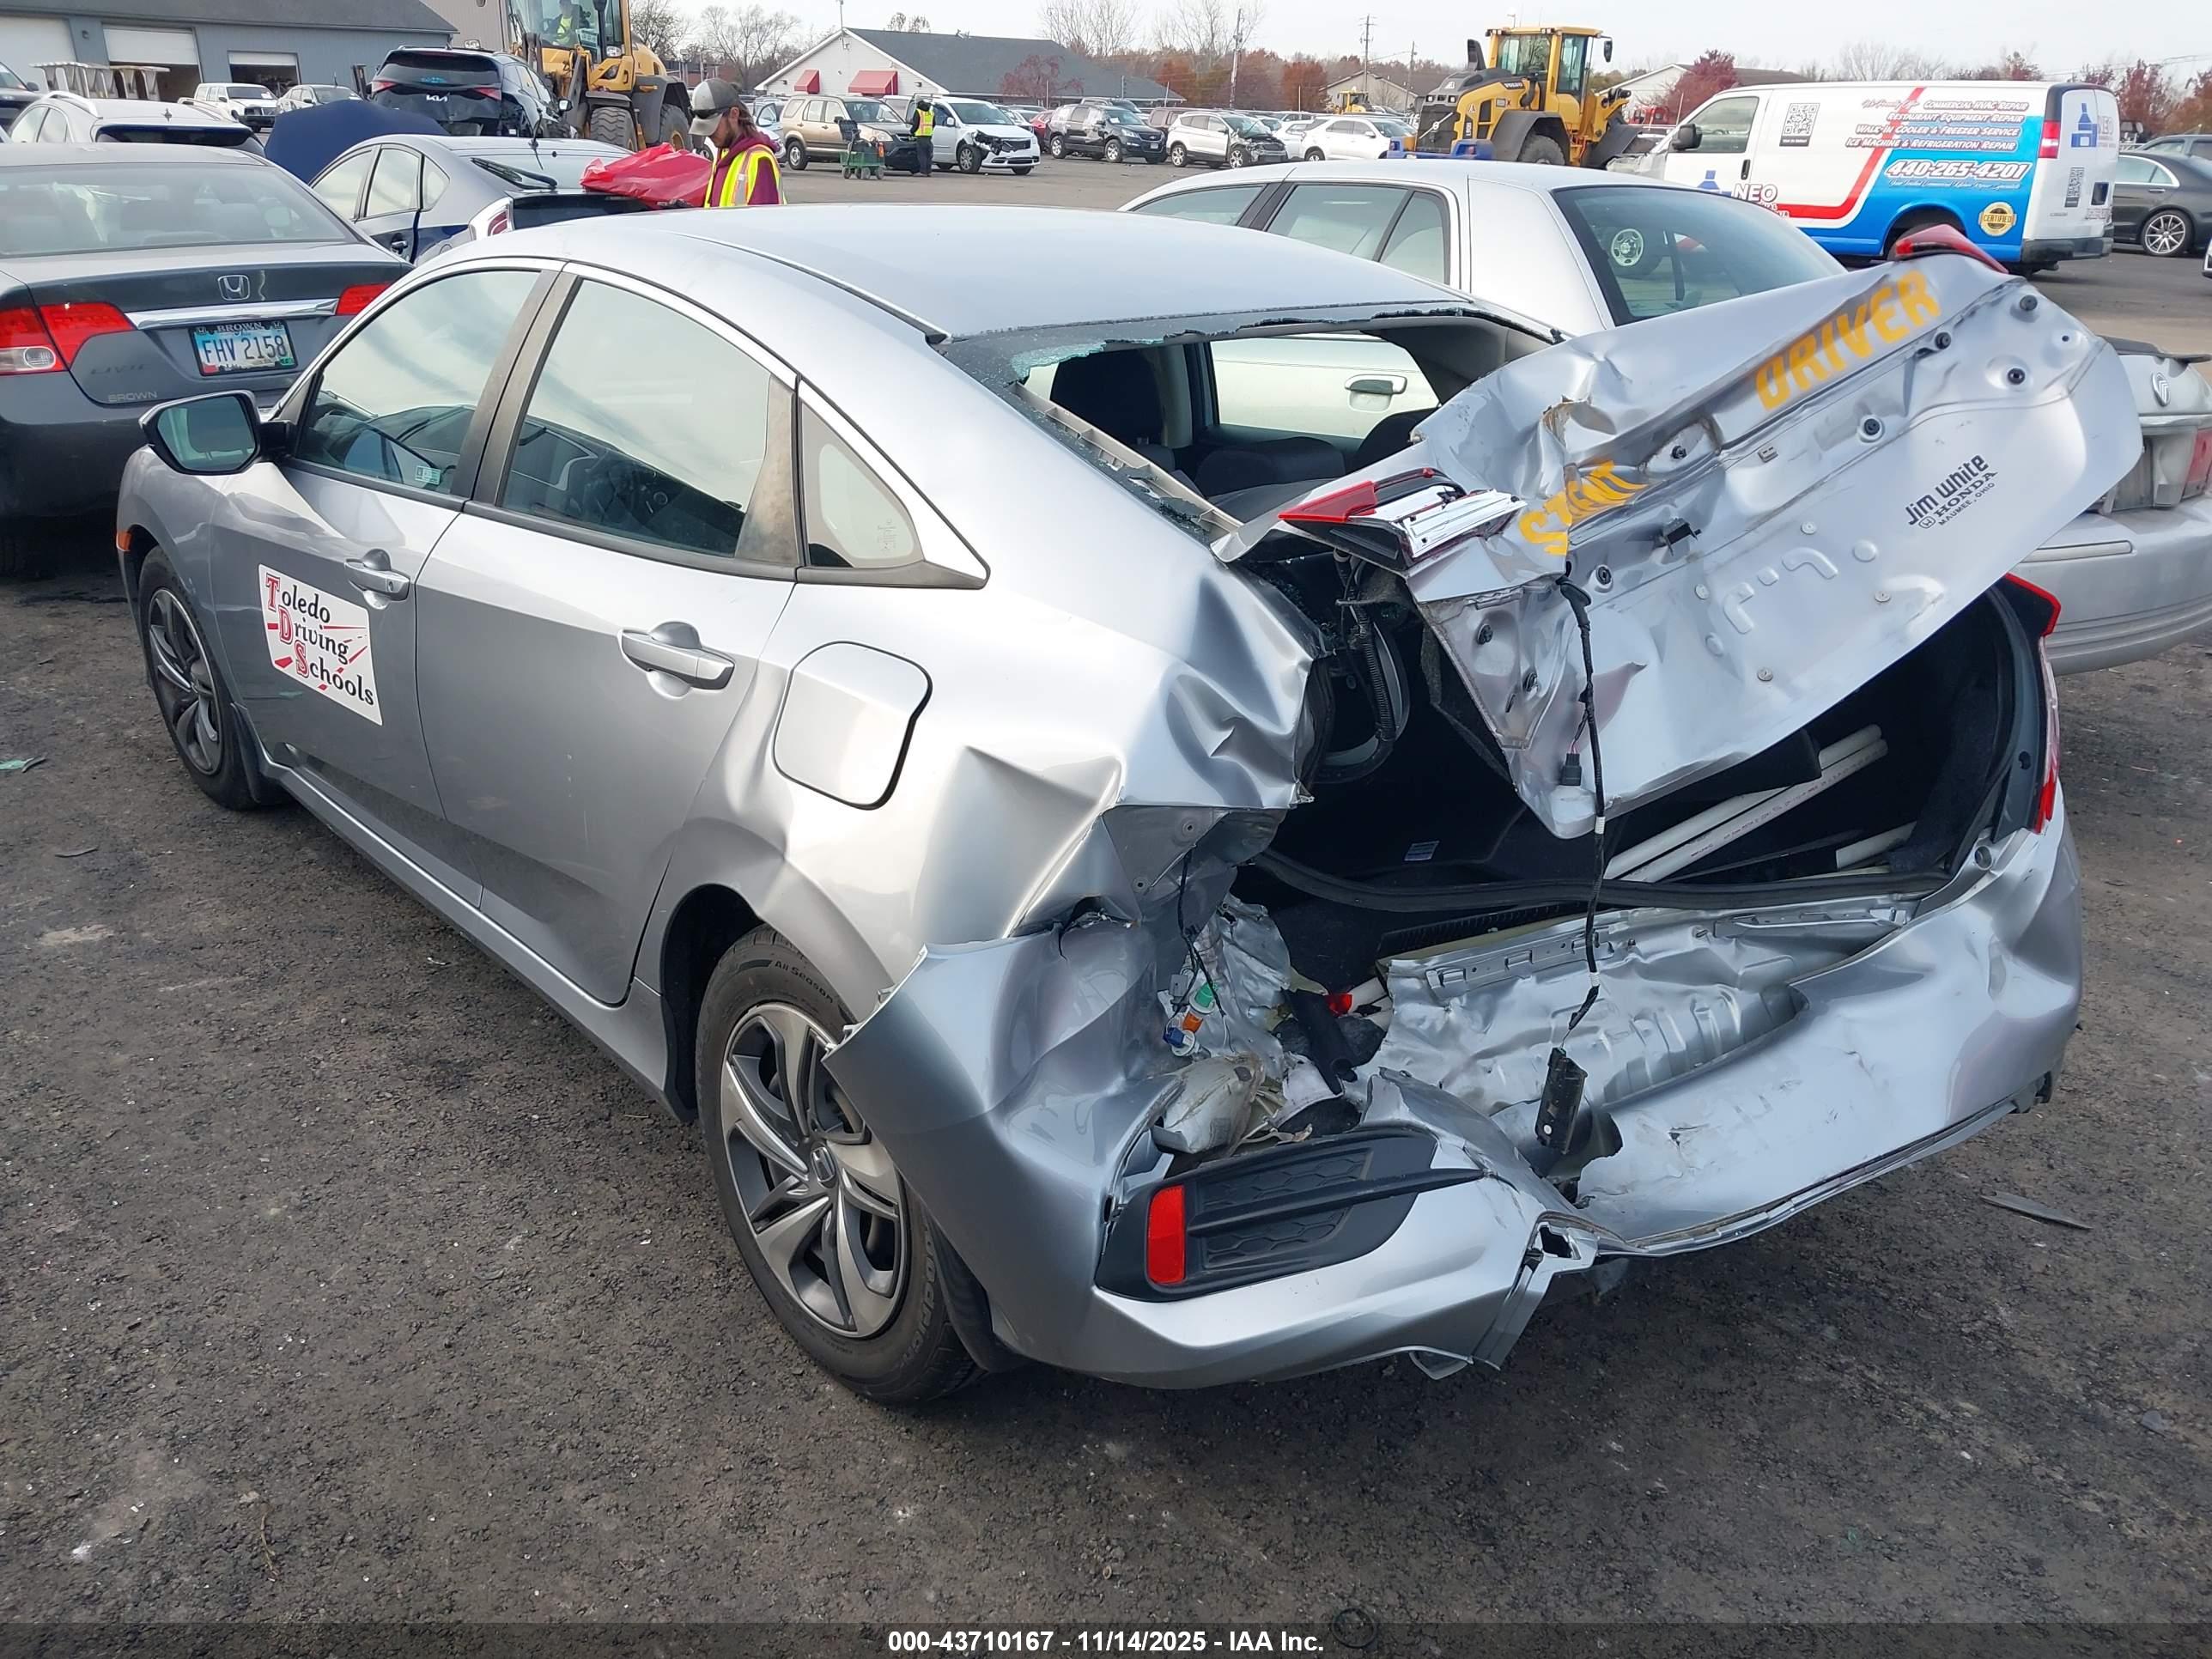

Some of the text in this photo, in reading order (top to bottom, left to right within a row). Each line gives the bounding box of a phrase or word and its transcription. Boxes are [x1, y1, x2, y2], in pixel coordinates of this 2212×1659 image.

[1924, 100, 1972, 110] COMMERCIAL
[1973, 100, 1996, 110] HVAC
[1998, 100, 2029, 111] REPAIR
[1887, 112, 2025, 124] RESTAURANT EQUIPMENT REPAIR
[1856, 125, 2020, 137] WALK-IN COOLER & FREEZER SERVICE
[1845, 138, 2016, 150] ICE MACHINE & REFRIGERATION REPAIR
[1887, 161, 2030, 179] 440-265-4201
[1734, 183, 1778, 203] NEO
[1983, 214, 2013, 223] CERTIFIED
[216, 322, 265, 333] BROWN
[202, 335, 288, 362] FHV 2158
[1755, 270, 1942, 411] DRIVER
[1933, 471, 1999, 517] HONDA
[1975, 483, 1996, 498] OHIO
[1905, 495, 1939, 526] Jim
[266, 573, 331, 623] Toledo
[278, 605, 349, 665] Driving
[294, 640, 374, 706] Schools
[775, 960, 834, 1004] All Season
